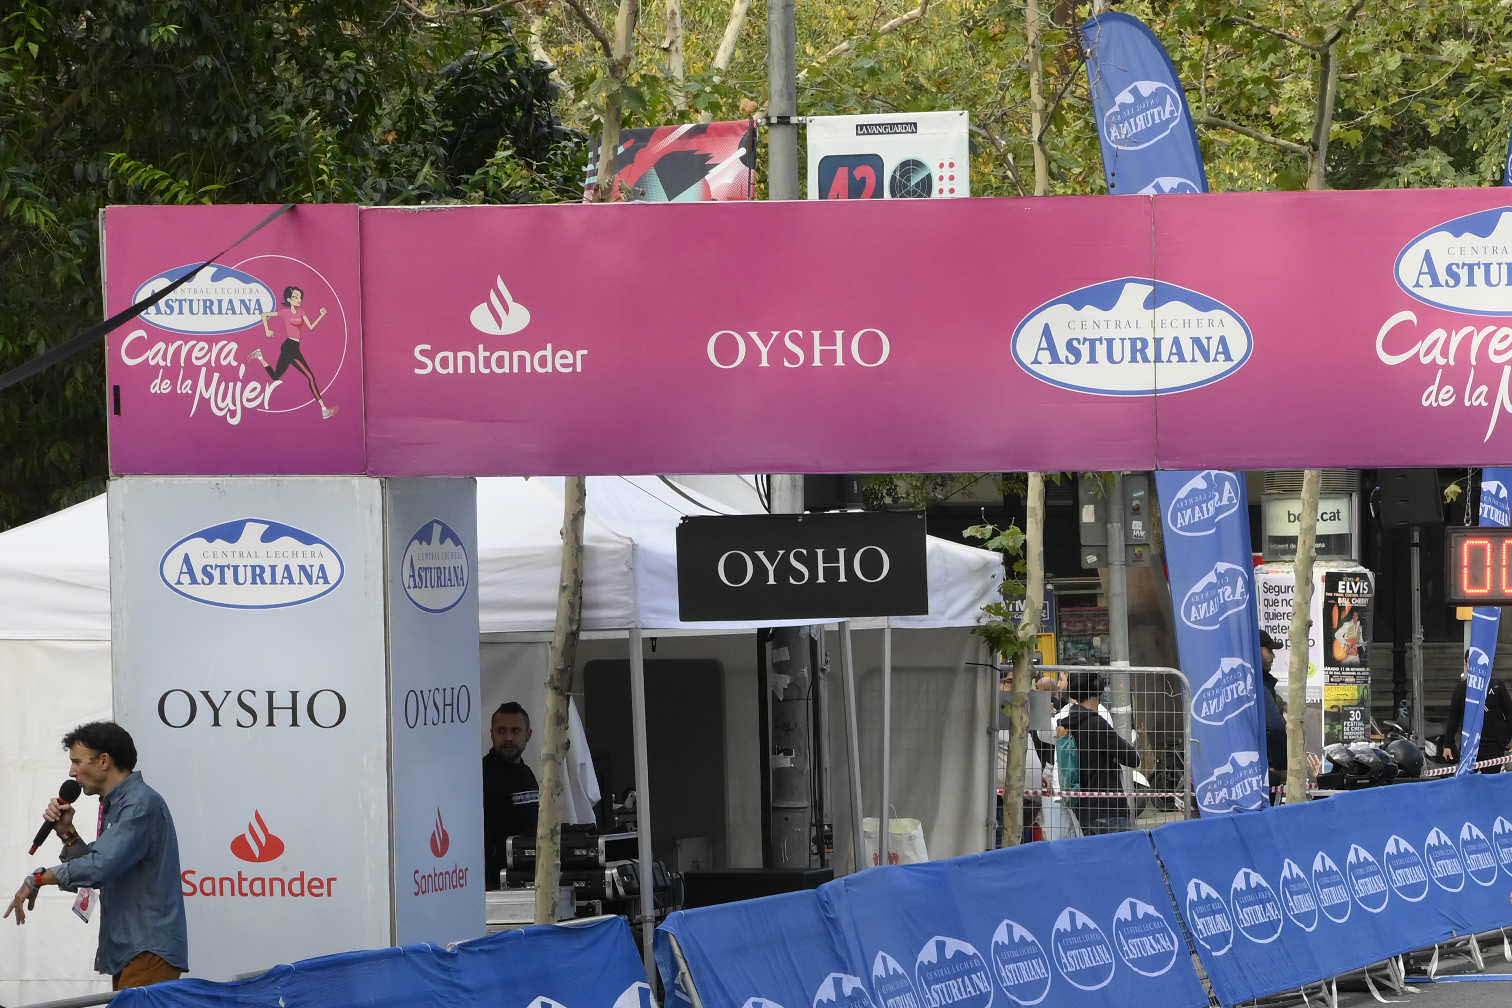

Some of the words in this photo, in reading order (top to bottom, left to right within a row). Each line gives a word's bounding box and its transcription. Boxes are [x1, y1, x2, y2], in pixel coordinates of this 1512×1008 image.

[1068, 319, 1141, 330] CENTRAL
[121, 330, 238, 366] Carrera
[414, 342, 588, 376] Santander
[707, 328, 890, 368] OYSHO
[1031, 323, 1234, 365] ASTURIANA
[150, 369, 172, 394] de
[177, 369, 192, 394] la
[190, 364, 283, 425] Mujer
[1421, 369, 1455, 407] de
[1464, 367, 1488, 407] la
[175, 552, 330, 586] ASTURIANA
[203, 550, 262, 559] CENTRAL
[267, 550, 324, 559] LECHERA
[717, 545, 890, 587] OYSHO
[407, 556, 465, 590] ASTURIANA
[1338, 581, 1369, 594] ELVIS
[158, 688, 347, 728] OYSHO
[405, 685, 471, 728] OYSHO
[182, 870, 337, 898] Santander
[414, 865, 469, 896] Santander
[996, 955, 1048, 987] ASTURIANA
[1057, 941, 1112, 973] ASTURIANA
[921, 971, 991, 1008] ASTURIANA
